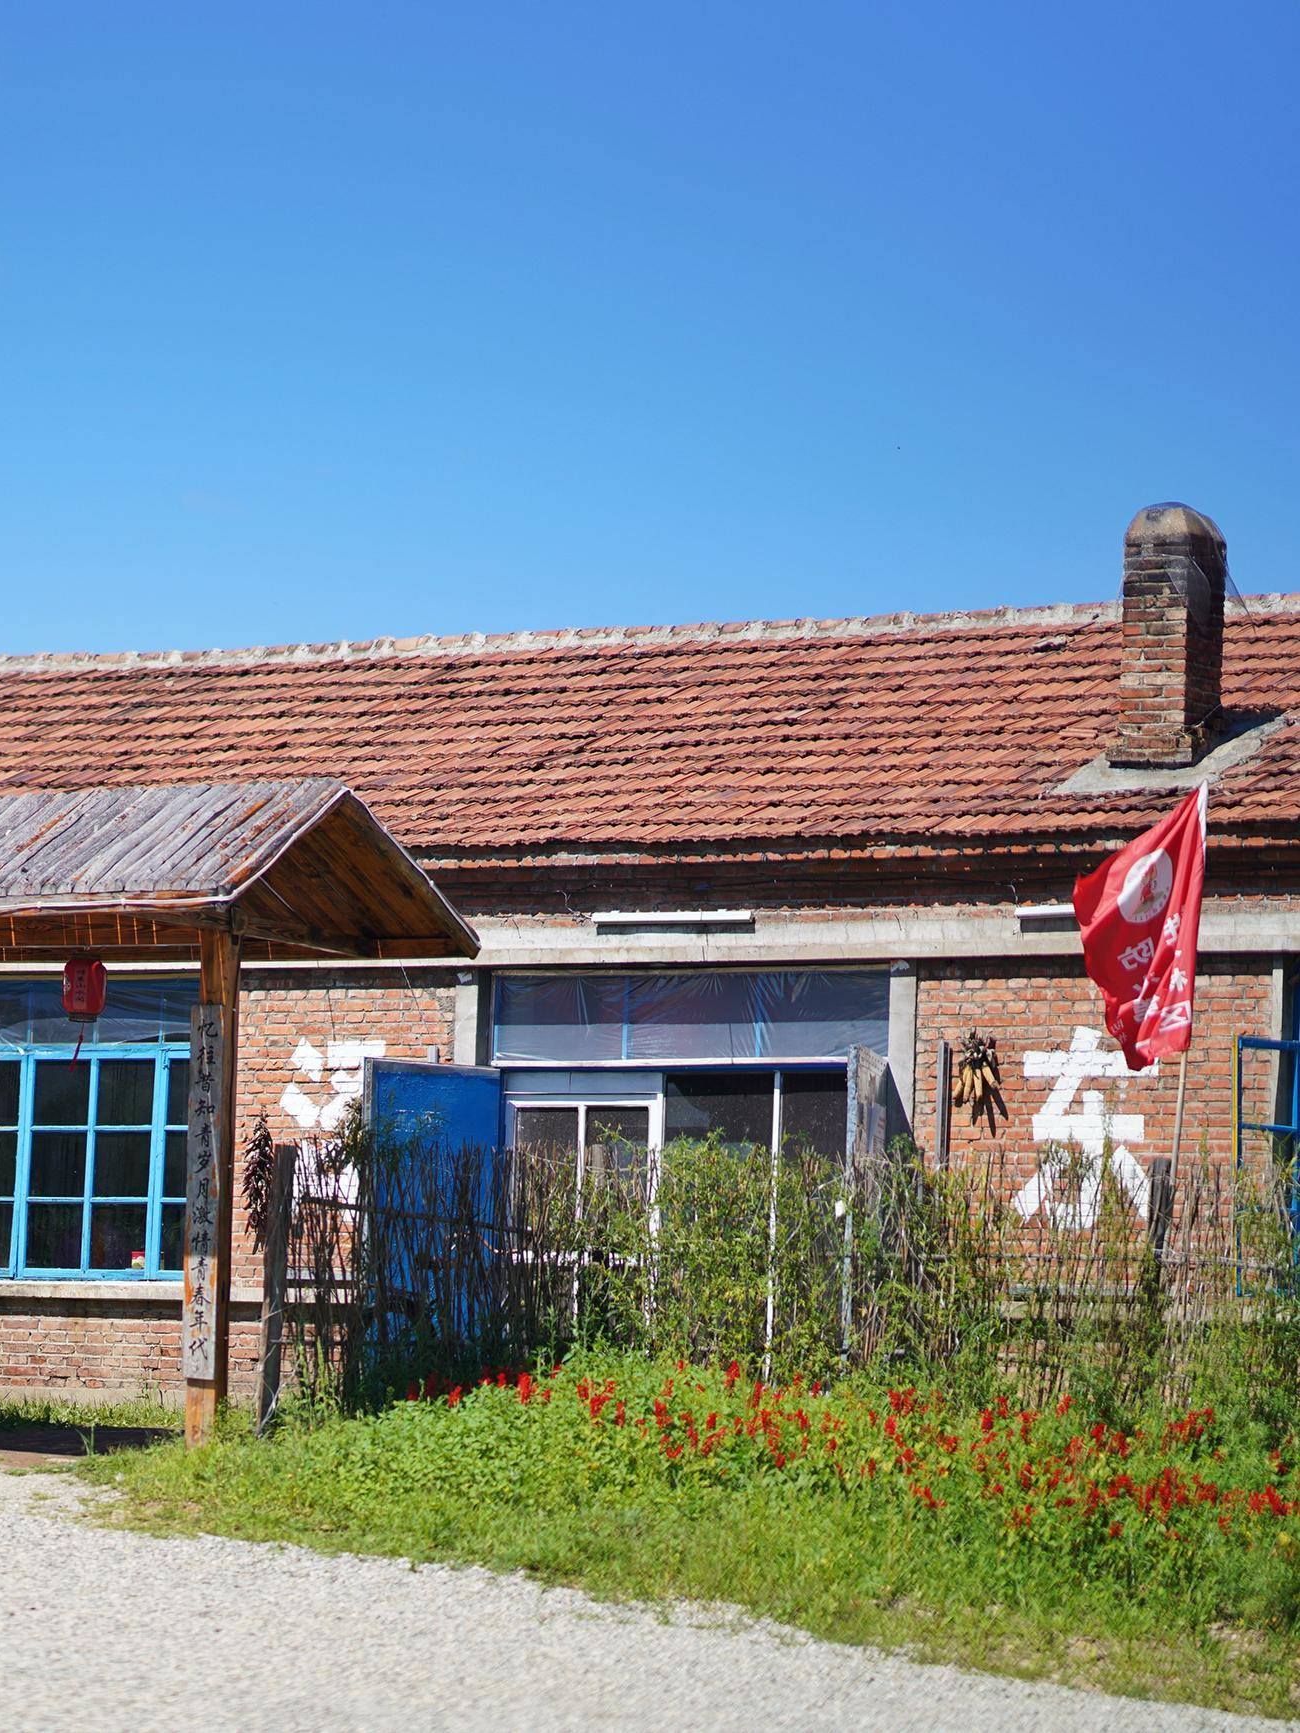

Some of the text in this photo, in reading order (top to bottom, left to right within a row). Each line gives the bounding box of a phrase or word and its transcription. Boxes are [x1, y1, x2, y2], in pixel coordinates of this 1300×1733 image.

[188, 1018, 219, 1361] 忆往昔知青岁月激情青春年代
